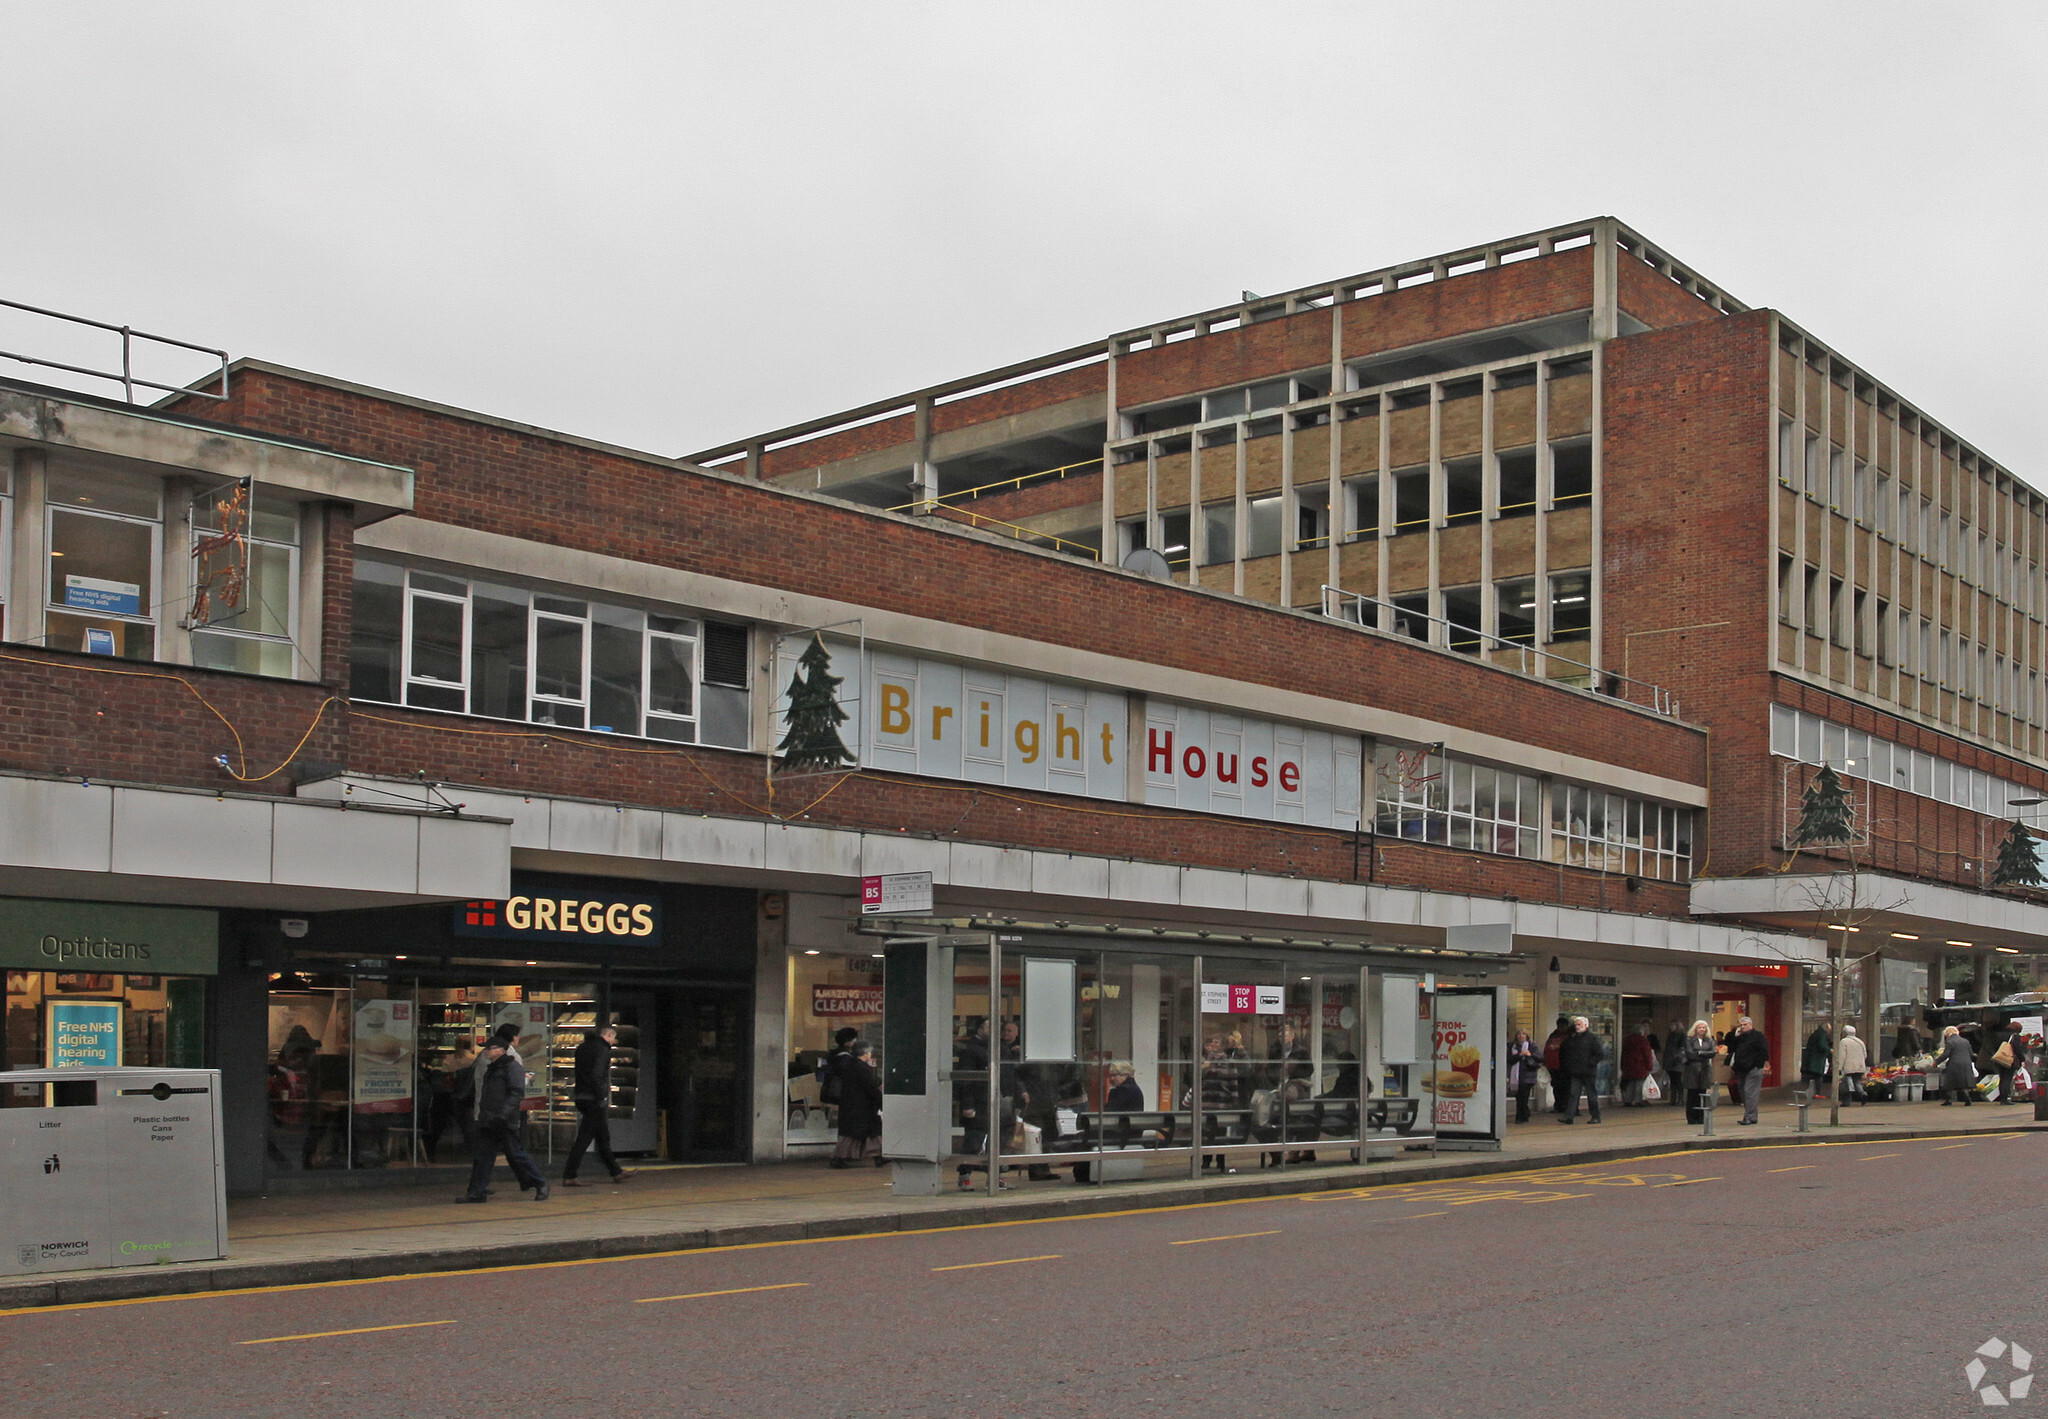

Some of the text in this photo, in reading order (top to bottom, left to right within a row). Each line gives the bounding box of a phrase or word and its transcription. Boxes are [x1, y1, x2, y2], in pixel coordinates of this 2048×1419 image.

[68, 596, 95, 605] hearing
[69, 589, 84, 597] Free
[100, 593, 121, 602] digital
[881, 683, 1300, 793] Bright House
[866, 888, 879, 898] BS
[505, 896, 654, 937] GREGGS
[40, 934, 151, 962] Opticians
[815, 989, 883, 999] AMAZING STOC
[1235, 988, 1250, 996] STOP
[815, 1000, 883, 1013] CLEARANC
[1236, 997, 1249, 1009] BS
[58, 1021, 114, 1033] Free NHS
[58, 1034, 98, 1047] digital
[58, 1046, 106, 1060] hearing
[39, 1121, 61, 1129] Litter
[41, 1241, 88, 1250] NORWICH
[138, 1240, 172, 1251] recycle
[41, 1251, 58, 1259] City
[60, 1249, 89, 1257] Council
